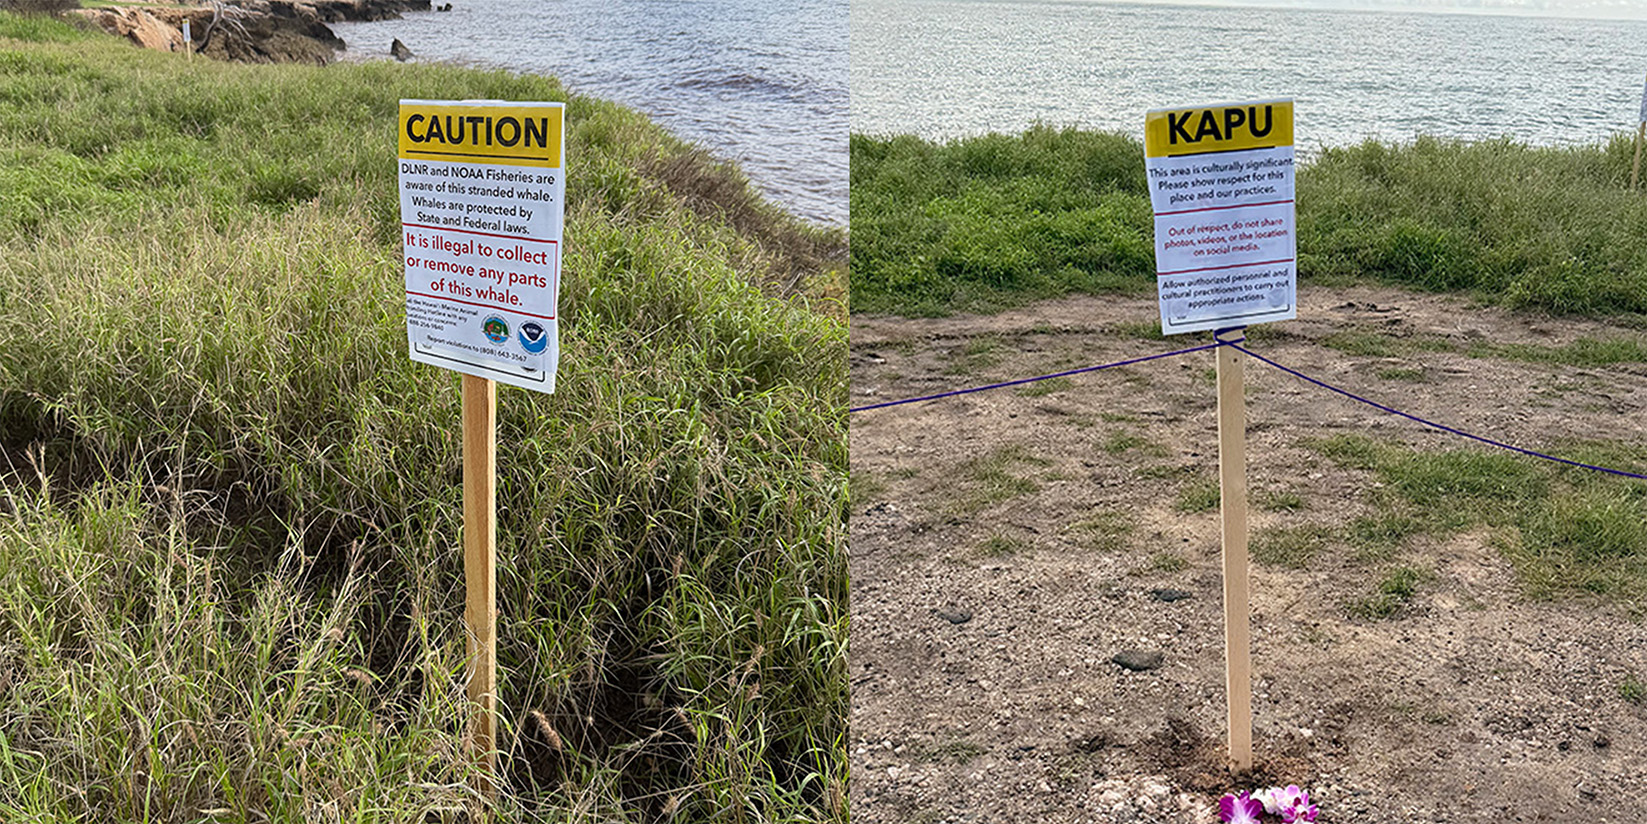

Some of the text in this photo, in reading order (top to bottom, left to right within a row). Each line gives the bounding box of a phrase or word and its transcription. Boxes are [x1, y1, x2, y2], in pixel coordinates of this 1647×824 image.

[406, 114, 548, 148] CAUTION
[1168, 105, 1272, 145] KAPU
[402, 163, 555, 185] DLNR and NOAA Fisheries are
[1149, 168, 1168, 178] This
[1170, 168, 1191, 177] area
[1192, 165, 1200, 174] is
[1202, 161, 1244, 174] culturally
[1158, 171, 1284, 190] Please show respect for this
[405, 181, 553, 202] aware of this stranded whale.
[1170, 185, 1276, 205] place and our practices.
[412, 196, 533, 221] Whales are protected by
[417, 211, 530, 234] State and Federal laws.
[1168, 218, 1283, 237] Out of respect, do not share
[406, 232, 547, 265] It is illegal to collect
[1164, 239, 1196, 250] photos,
[1197, 236, 1227, 246] videos,
[1239, 231, 1253, 240] the
[1255, 229, 1288, 239] location
[1206, 245, 1230, 255] social
[1232, 242, 1260, 252] media.
[407, 256, 547, 288] or remove any parts
[1162, 268, 1288, 290] Allow authorized personnel and
[431, 278, 523, 306] of this whale.
[1162, 280, 1289, 300] cultural practitioners to carry out
[1188, 293, 1265, 309] appropriate actions.
[480, 347, 496, 357] (808)
